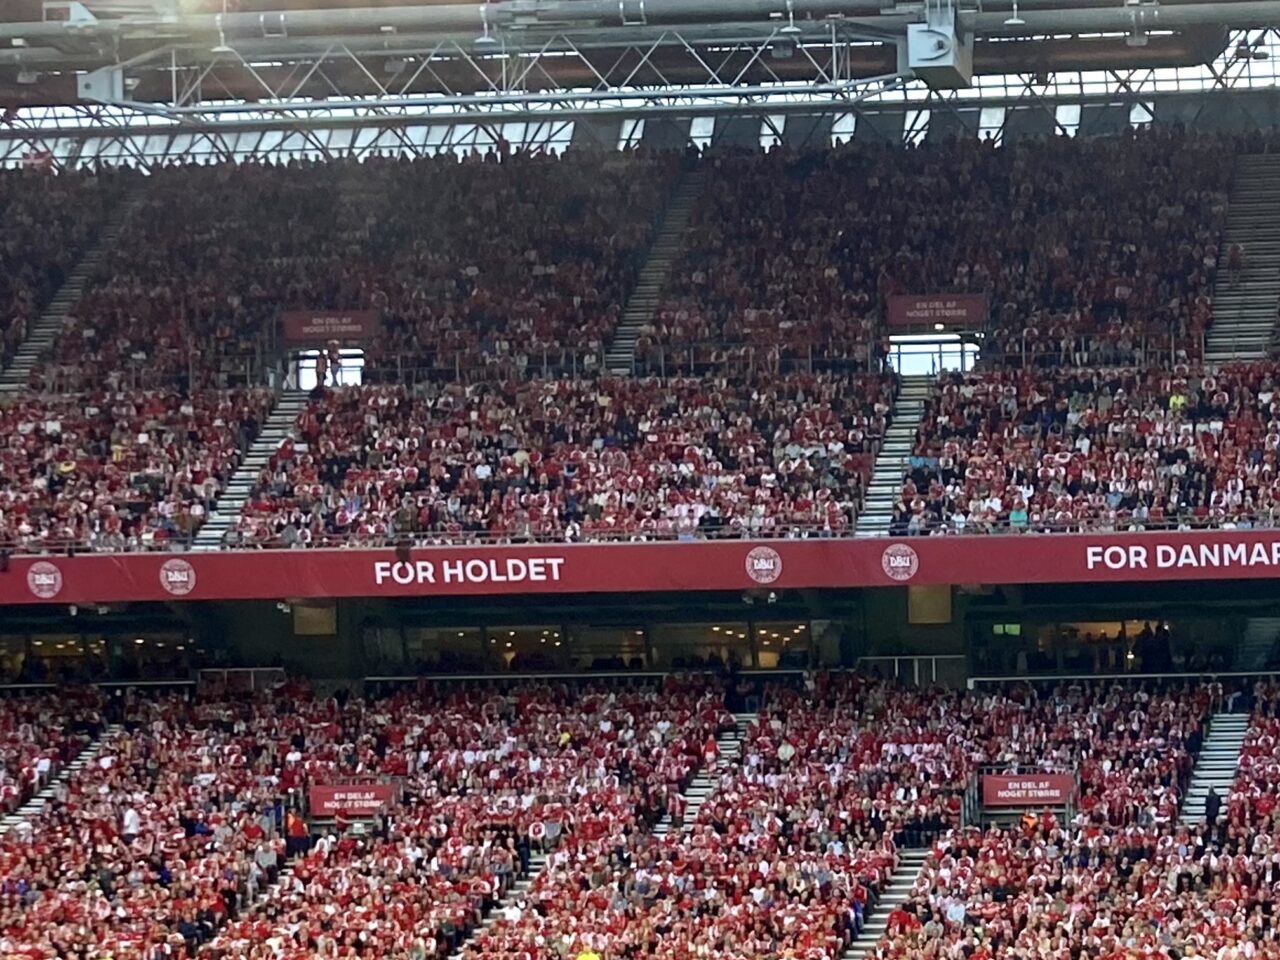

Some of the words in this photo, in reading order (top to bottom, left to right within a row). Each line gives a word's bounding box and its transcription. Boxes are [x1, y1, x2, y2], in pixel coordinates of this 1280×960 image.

[1086, 545, 1148, 569] FOR
[374, 561, 436, 584] FOR
[442, 558, 565, 583] HOLDET
[1021, 781, 1037, 789] DEL
[1039, 781, 1050, 789] AF
[334, 792, 346, 800] EN
